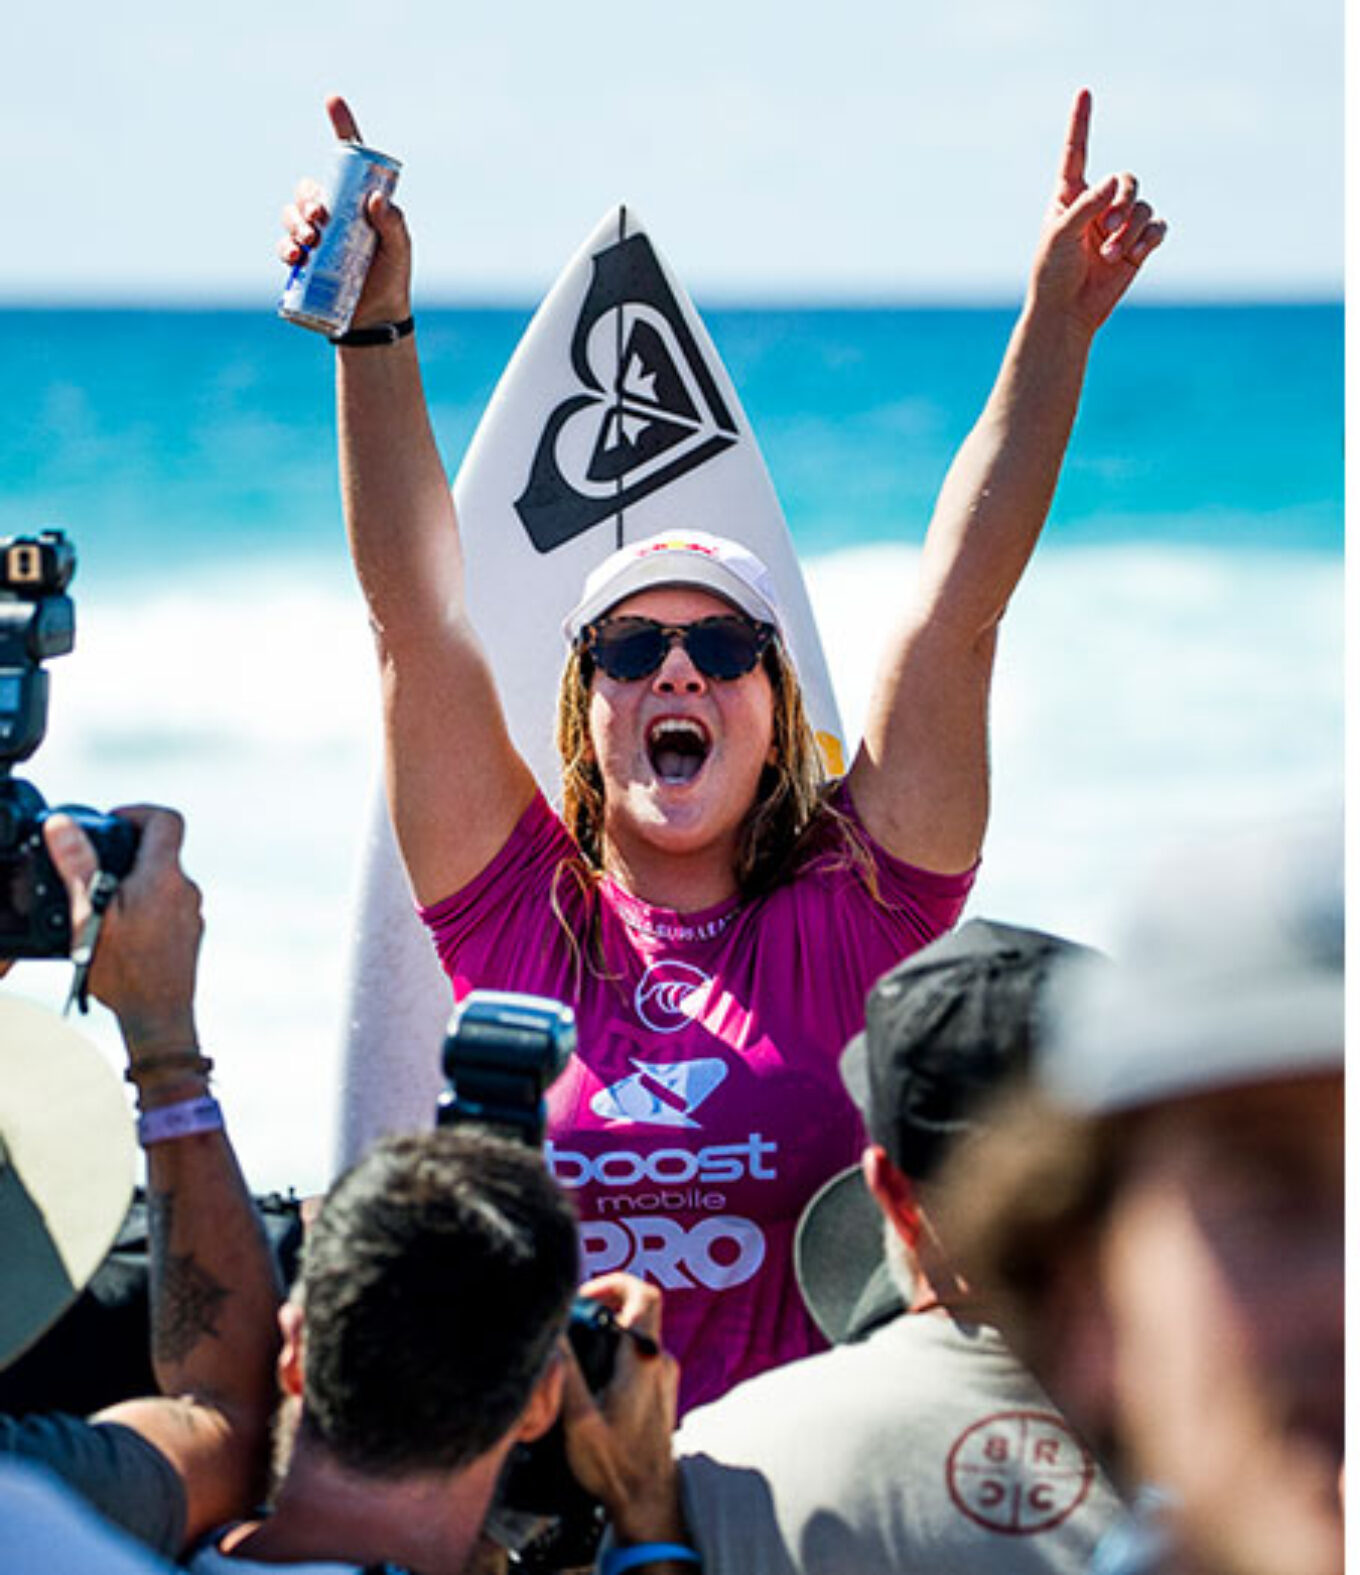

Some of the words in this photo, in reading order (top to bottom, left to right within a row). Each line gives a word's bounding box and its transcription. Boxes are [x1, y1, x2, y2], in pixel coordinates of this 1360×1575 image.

[543, 1132, 777, 1188] boost
[597, 1187, 726, 1213] mobile
[580, 1214, 766, 1291] PRO
